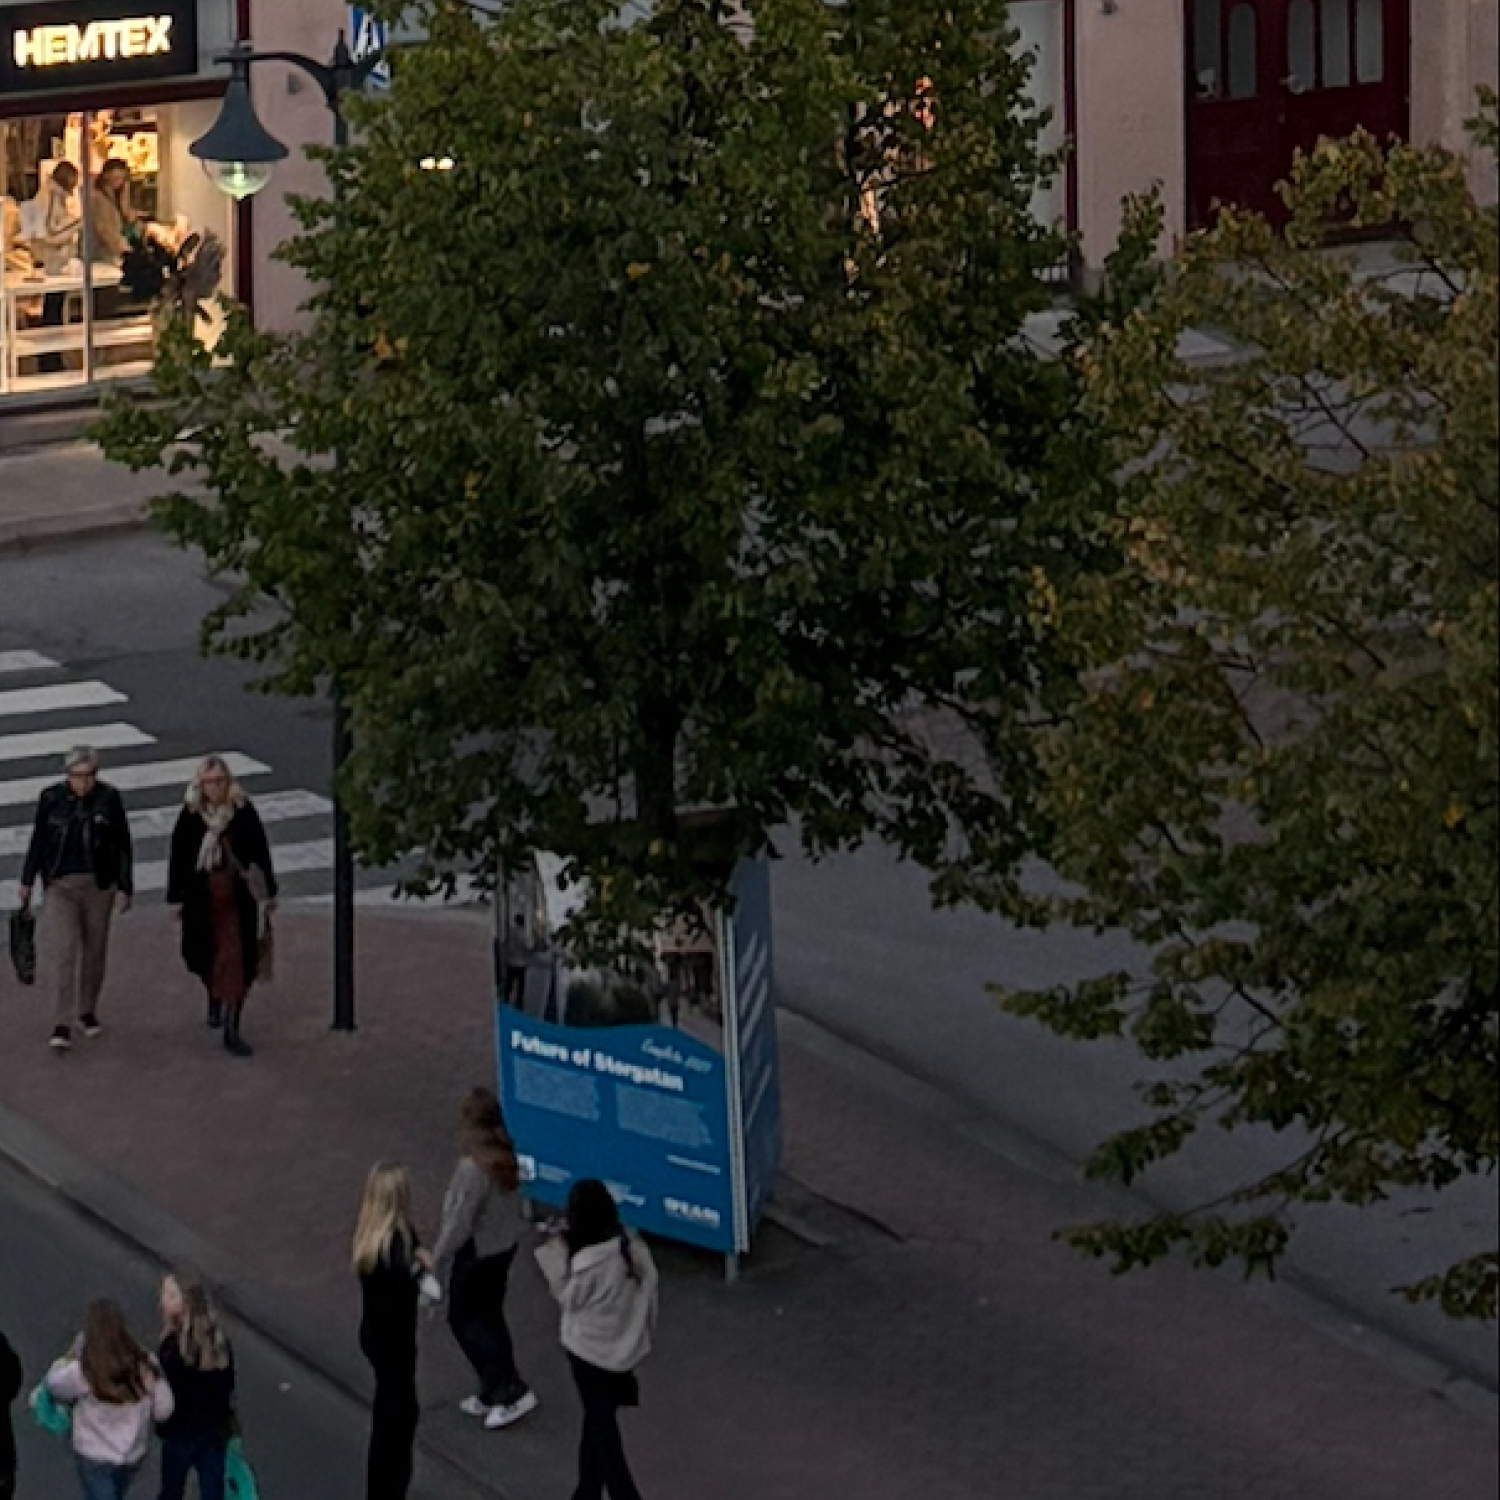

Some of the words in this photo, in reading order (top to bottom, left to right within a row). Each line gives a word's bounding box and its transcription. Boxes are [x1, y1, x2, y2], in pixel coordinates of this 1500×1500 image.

[14, 14, 173, 68] HEMTEX
[511, 1029, 569, 1062] Future
[571, 1048, 592, 1069] of
